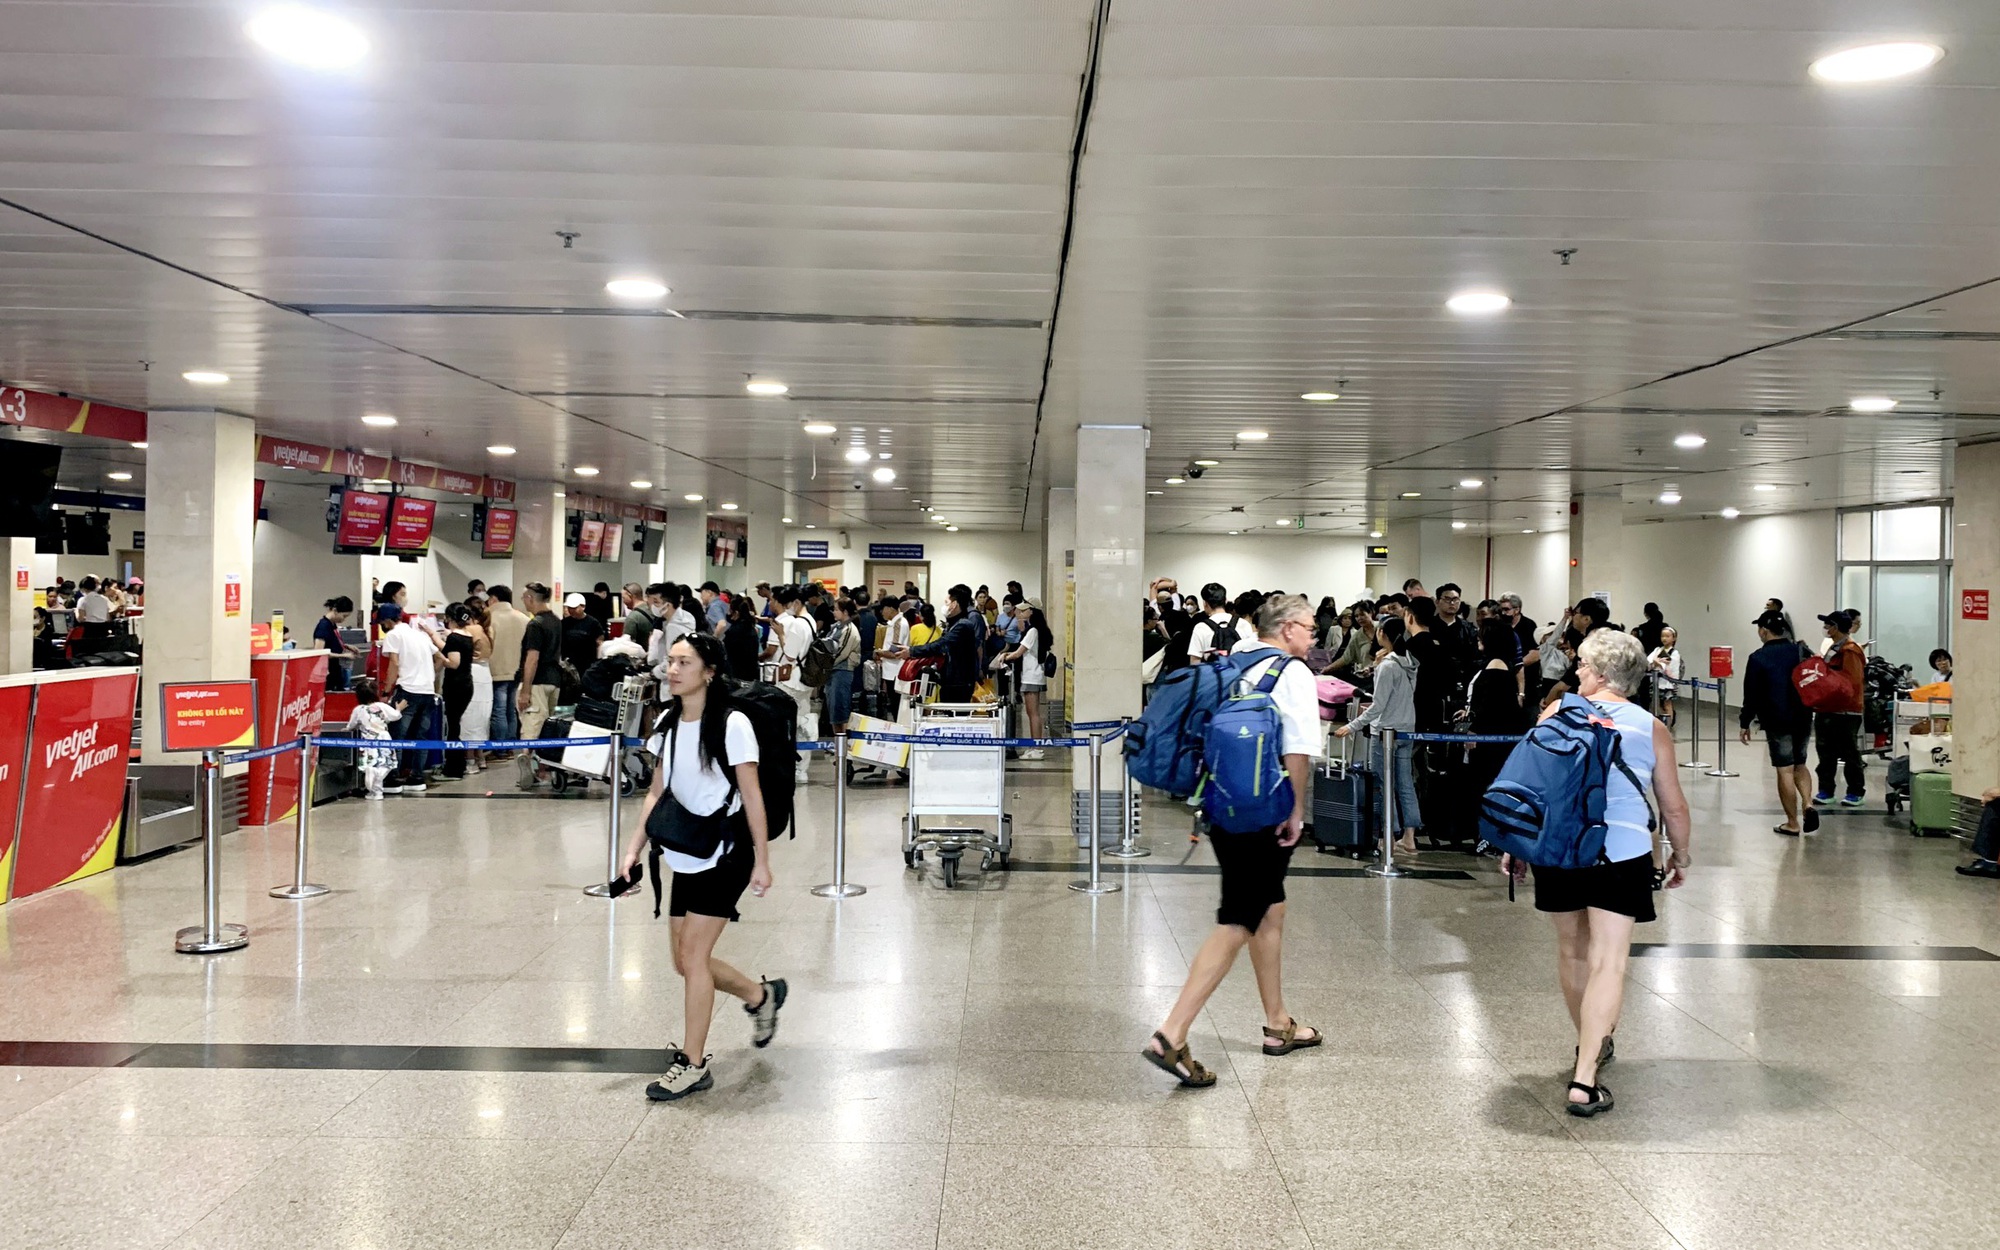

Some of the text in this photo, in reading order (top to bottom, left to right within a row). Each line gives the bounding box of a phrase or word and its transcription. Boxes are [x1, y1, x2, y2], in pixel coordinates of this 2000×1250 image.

[347, 453, 365, 477] K-5
[400, 463, 416, 484] K-6
[177, 709, 204, 718] KHÔNG
[215, 706, 227, 716] LỐI
[229, 706, 244, 716] NÀY
[863, 732, 882, 740] TIA
[816, 741, 835, 749] TIA
[1033, 738, 1053, 746] TIA
